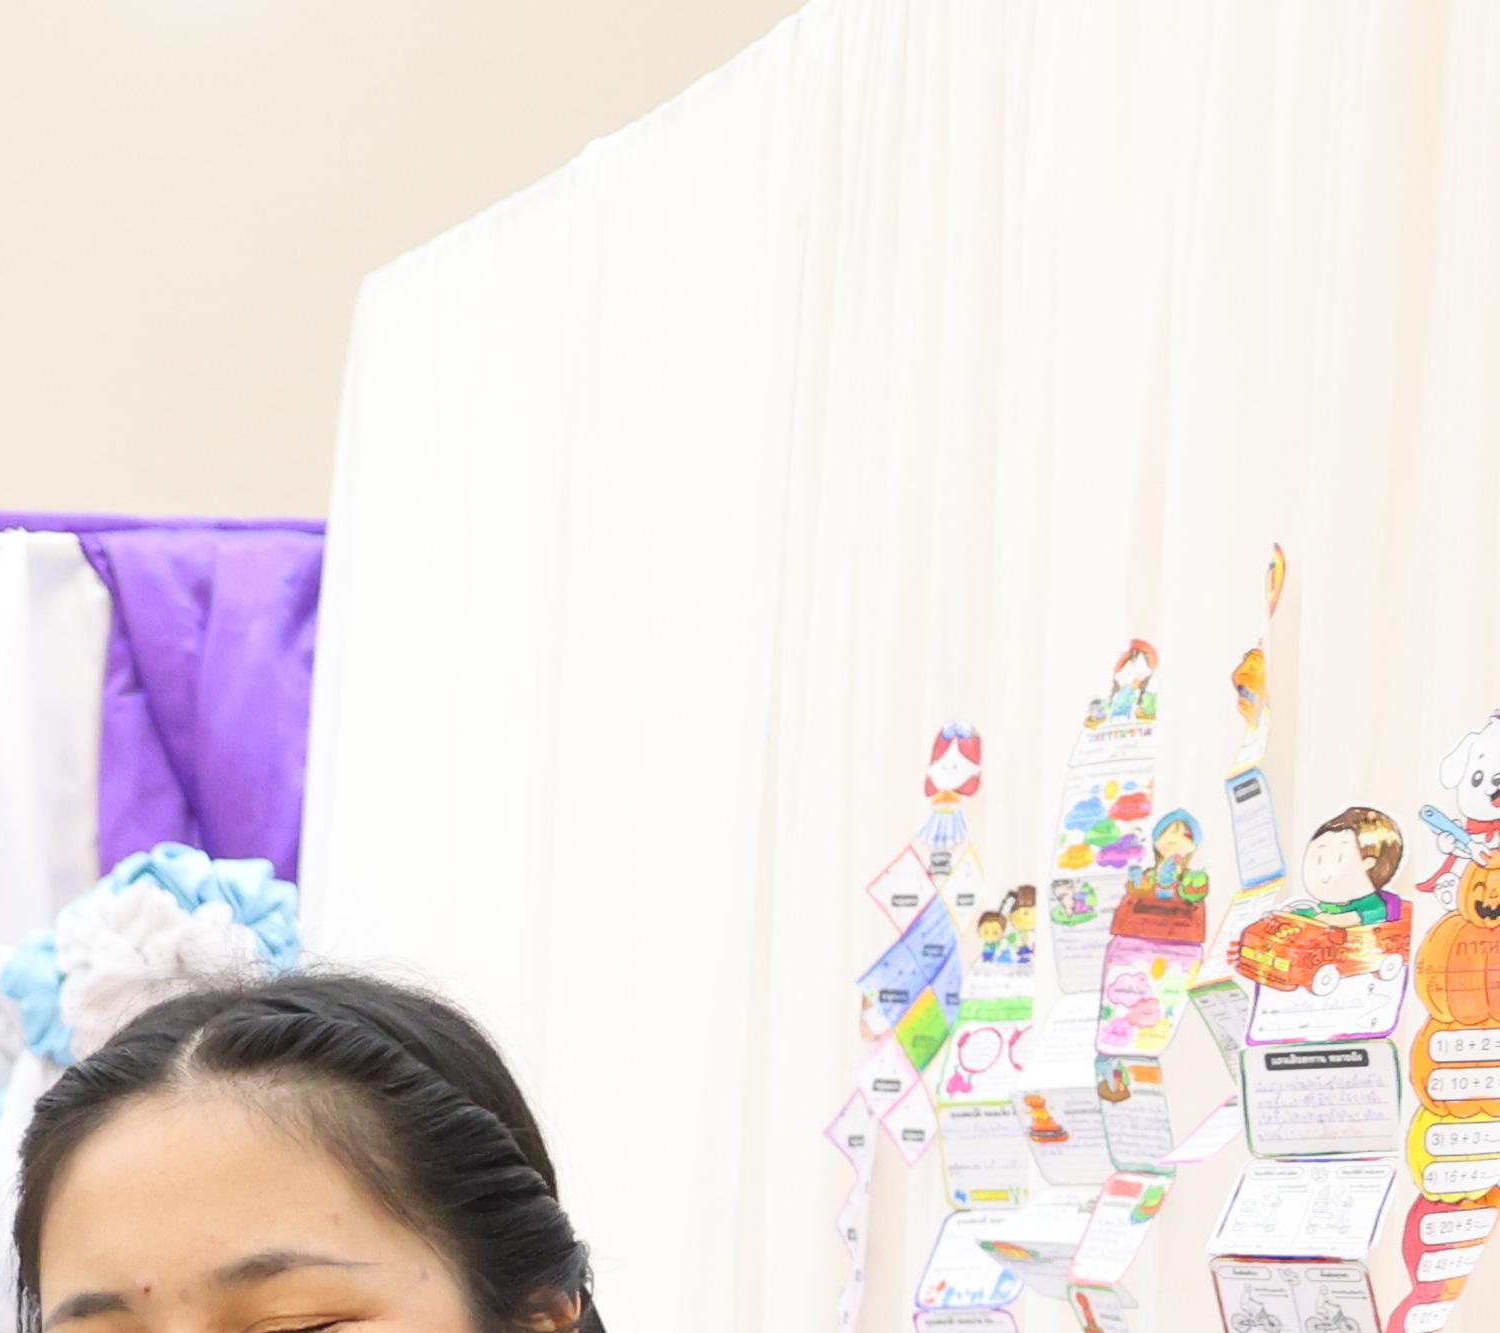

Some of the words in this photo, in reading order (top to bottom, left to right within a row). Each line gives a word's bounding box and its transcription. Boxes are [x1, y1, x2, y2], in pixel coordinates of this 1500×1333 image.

[1453, 1038, 1464, 1051] 8
[1481, 1037, 1492, 1051] 2
[1450, 1075, 1469, 1090] 10
[1448, 1132, 1459, 1146] 9
